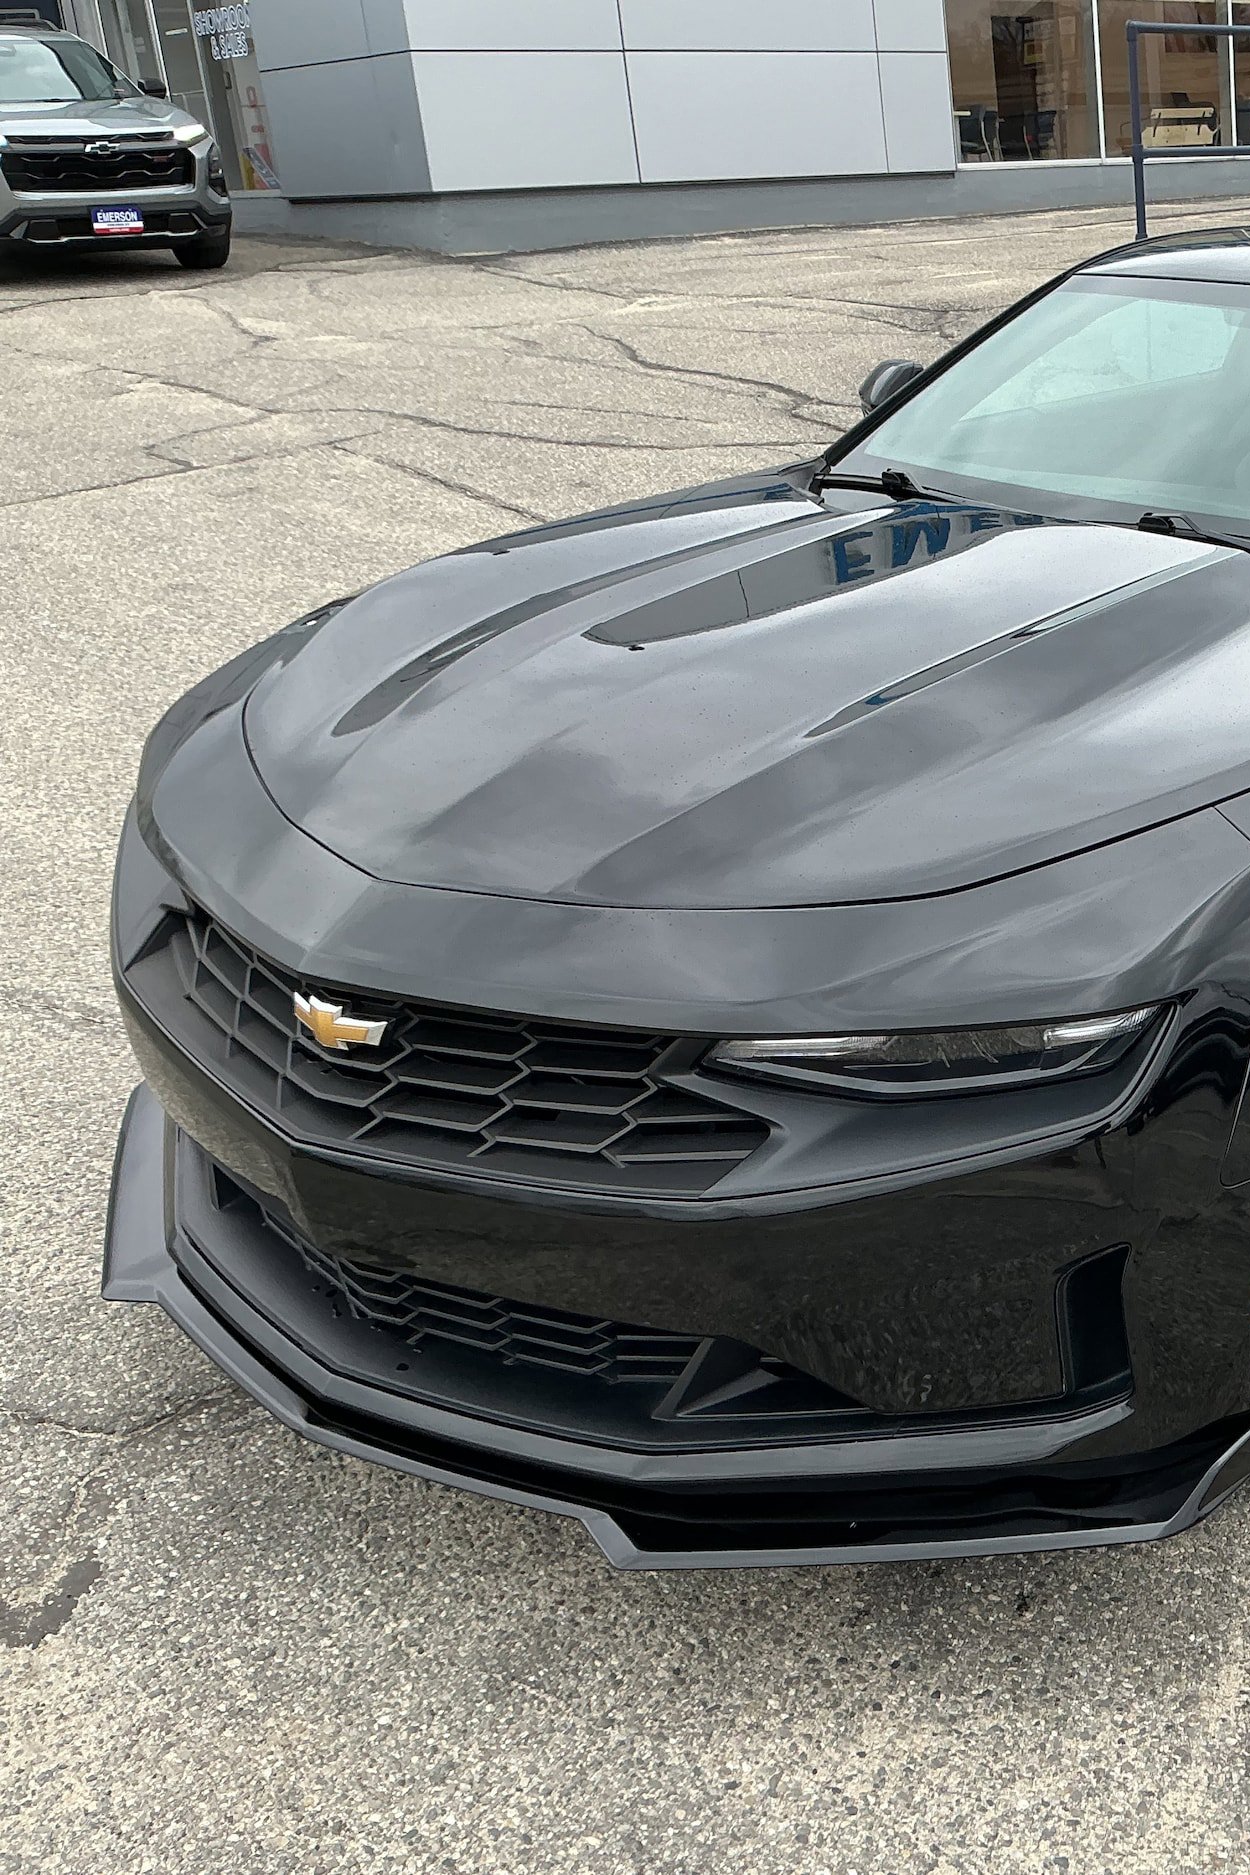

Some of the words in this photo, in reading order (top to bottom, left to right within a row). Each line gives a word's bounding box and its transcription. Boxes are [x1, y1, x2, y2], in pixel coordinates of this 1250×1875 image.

[210, 36, 221, 60] &
[219, 31, 248, 59] SALES
[97, 211, 137, 222] EMERSON
